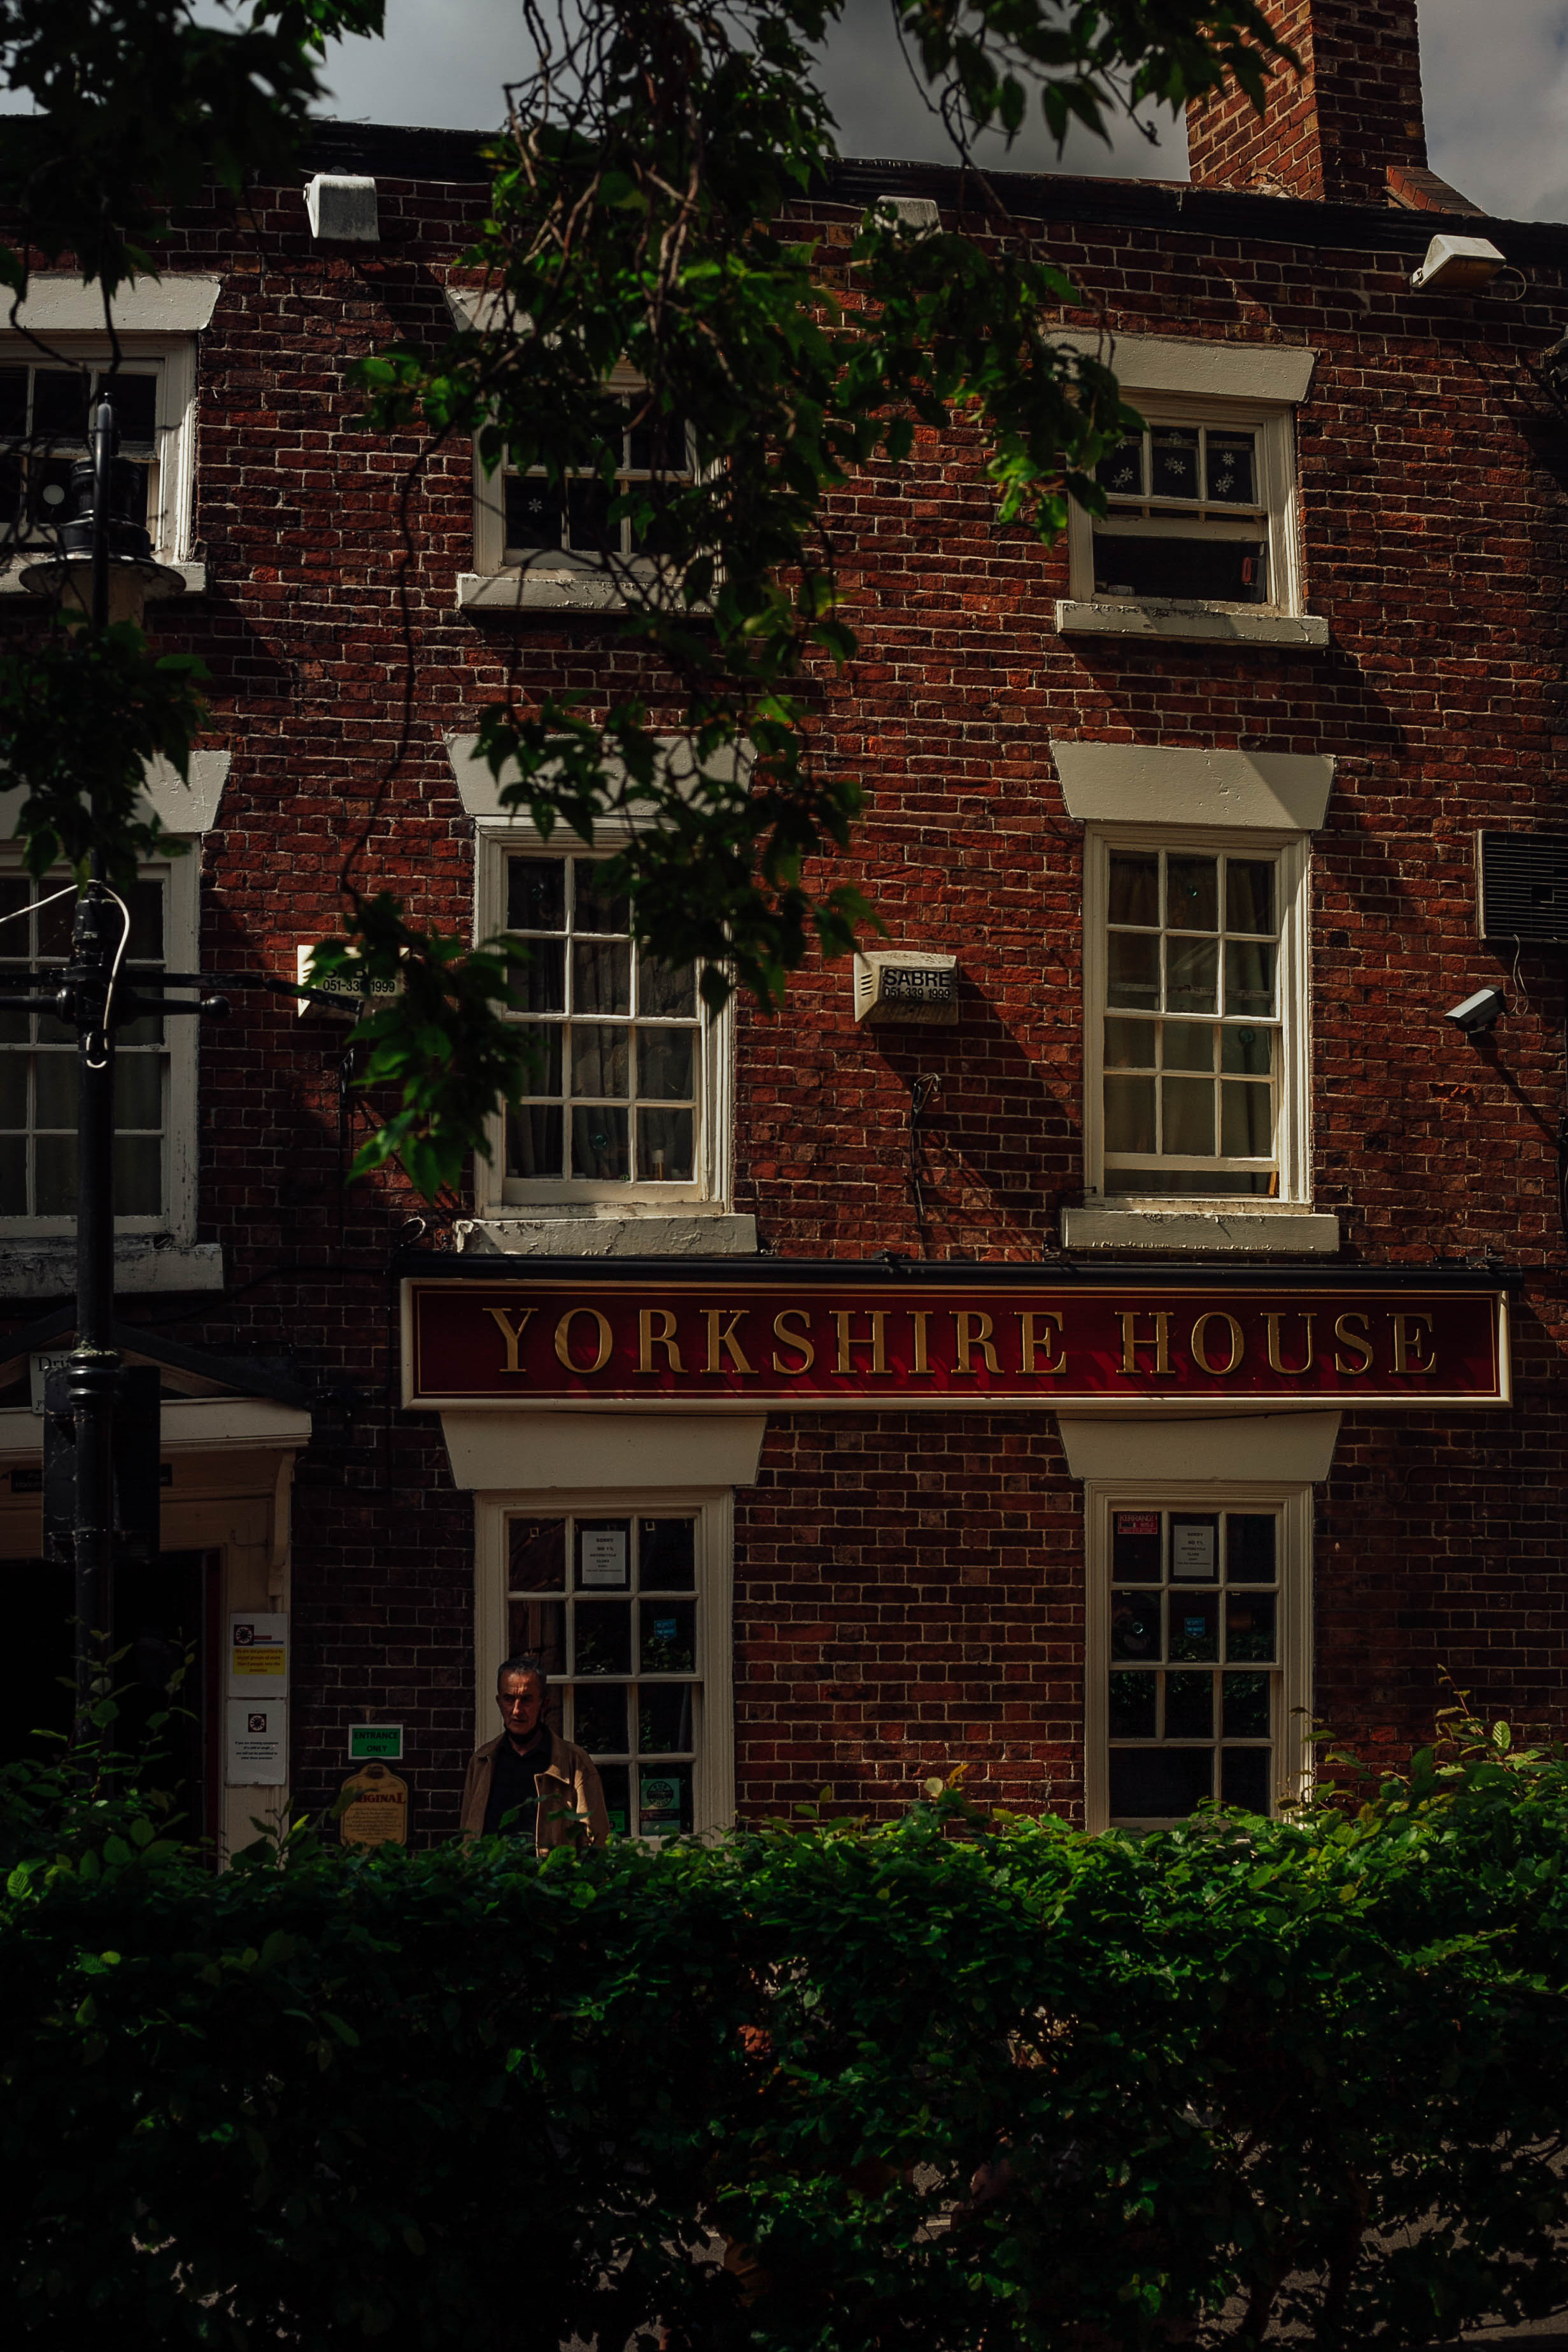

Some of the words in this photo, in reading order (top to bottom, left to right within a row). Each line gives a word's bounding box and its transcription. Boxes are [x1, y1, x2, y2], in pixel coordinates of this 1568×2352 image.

[885, 969, 949, 986] SABRE
[323, 979, 361, 991] 051-33
[371, 981, 395, 992] 1999
[884, 987, 923, 999] 051-339
[928, 988, 950, 999] 1999
[481, 1307, 1068, 1375] YORKSHIRE
[1114, 1312, 1437, 1375] HOUSE
